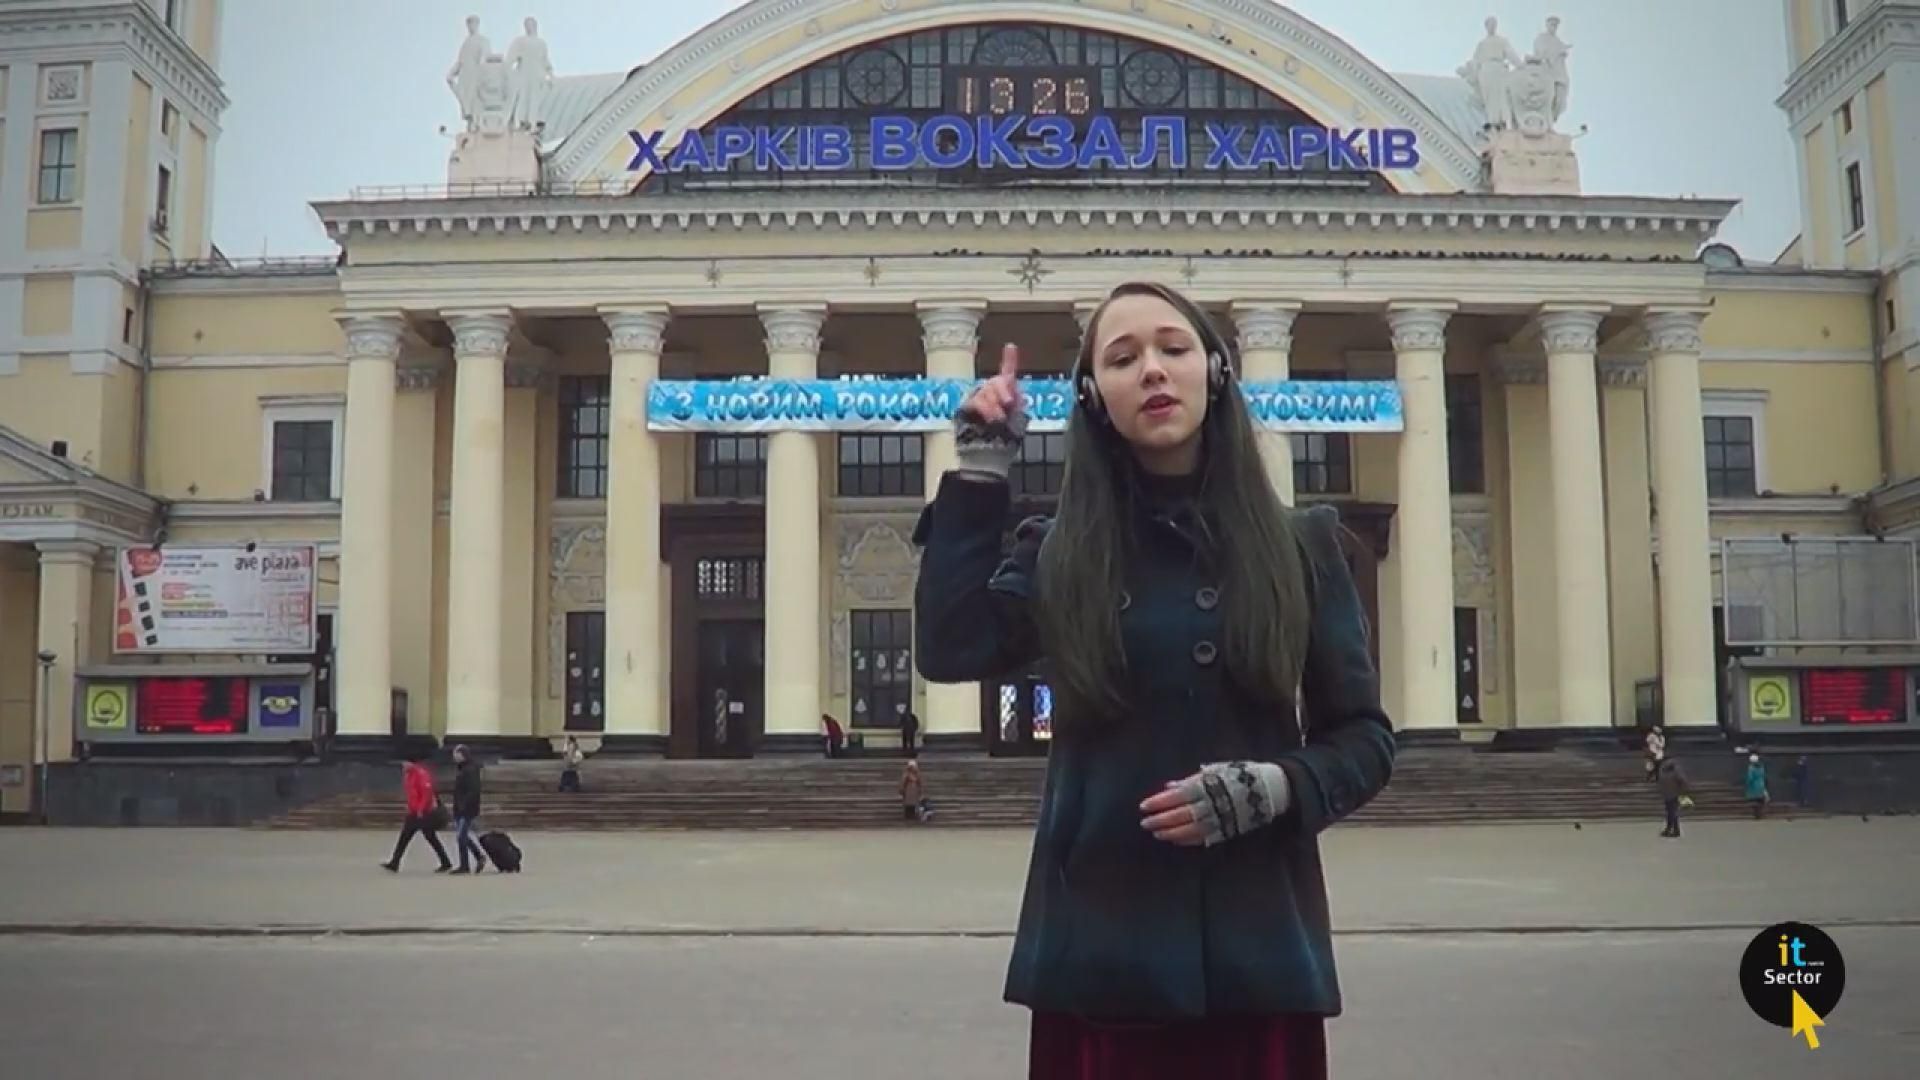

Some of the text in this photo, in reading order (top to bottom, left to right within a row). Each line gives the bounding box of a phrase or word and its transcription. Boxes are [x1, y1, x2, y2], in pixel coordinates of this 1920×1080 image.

[626, 114, 1420, 174] ХАРКІВ ВОКЗАЛ ХАРКІВ
[671, 391, 694, 421] З
[706, 391, 824, 422] НОВИМ
[836, 391, 951, 422] РОКОМ
[1249, 391, 1377, 422] ТОВИМ!
